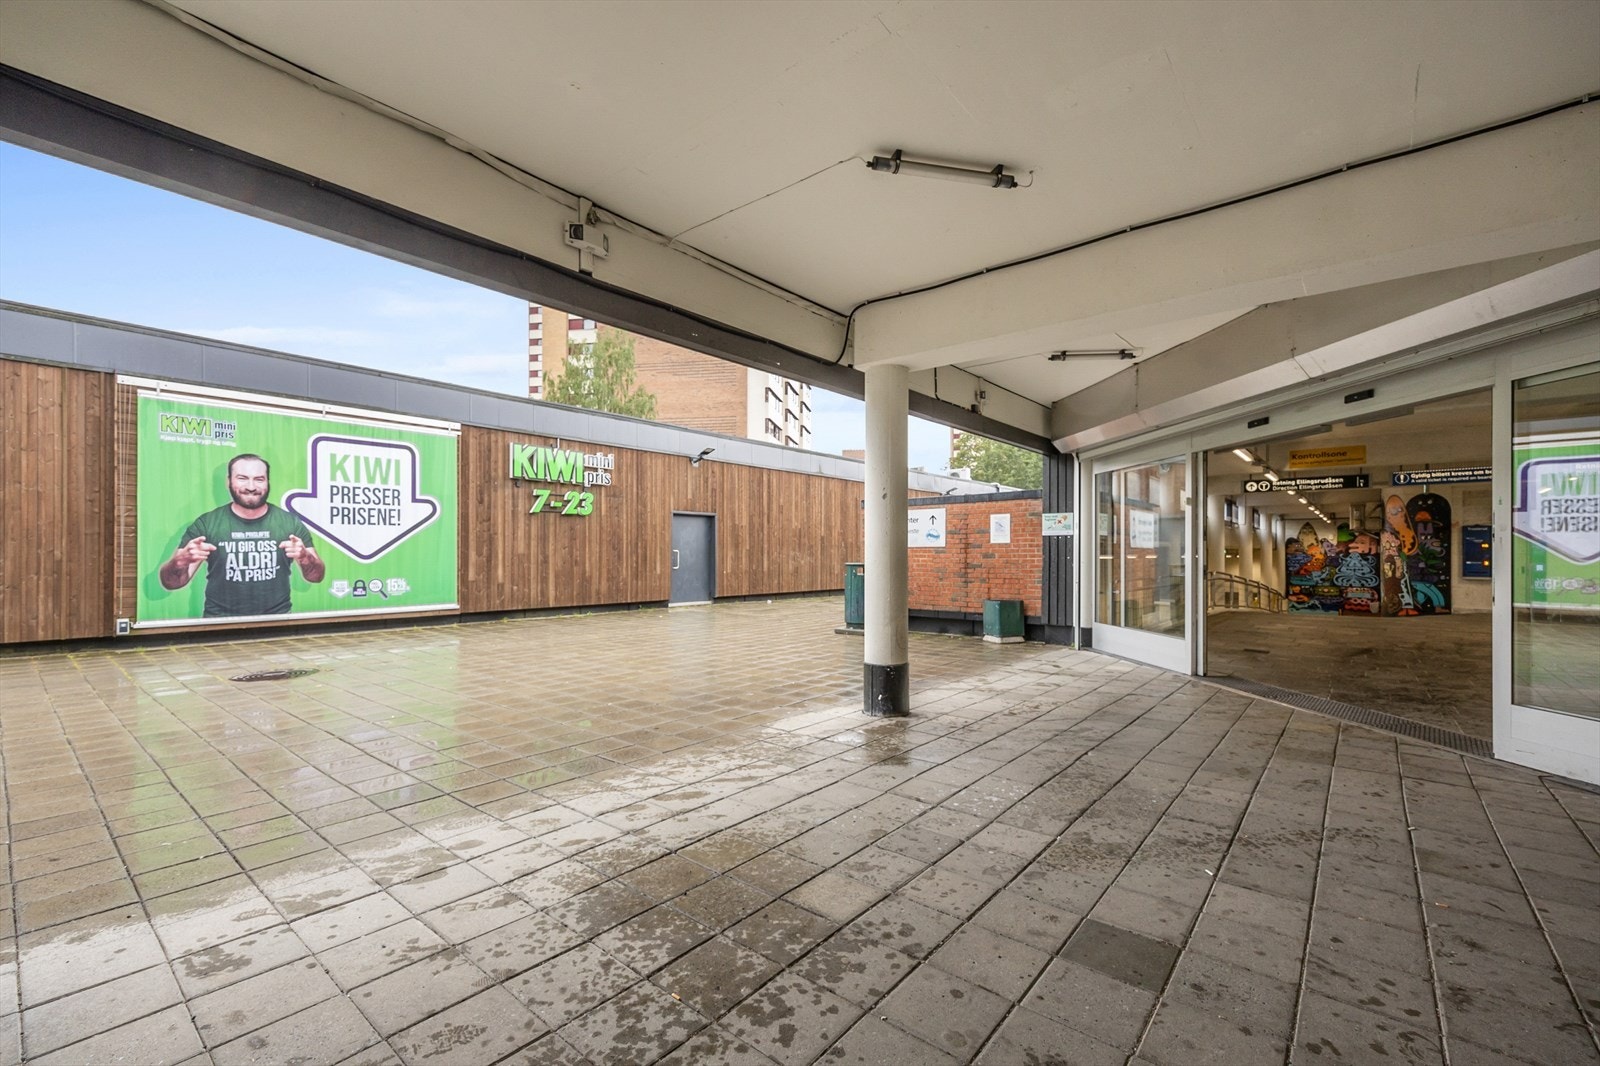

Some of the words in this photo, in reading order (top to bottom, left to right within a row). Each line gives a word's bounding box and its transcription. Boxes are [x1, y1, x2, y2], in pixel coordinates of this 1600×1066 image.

[160, 414, 211, 436] KIWI
[214, 422, 236, 430] mini
[214, 430, 234, 439] pris
[510, 442, 584, 485] KIWI
[584, 452, 614, 470] mini
[1291, 451, 1348, 460] Kontrollsone
[329, 453, 401, 486] KIWI
[584, 469, 612, 487] pris
[1272, 479, 1296, 487] Retning
[1296, 477, 1344, 486] Ellingsrudåsen
[1298, 482, 1343, 491] Ellingsrudåsen
[329, 485, 401, 506] PRESSER
[329, 506, 401, 526] PRISENE!
[238, 540, 256, 553] GIR
[257, 540, 277, 552] OSS
[225, 551, 277, 570] ALDRI
